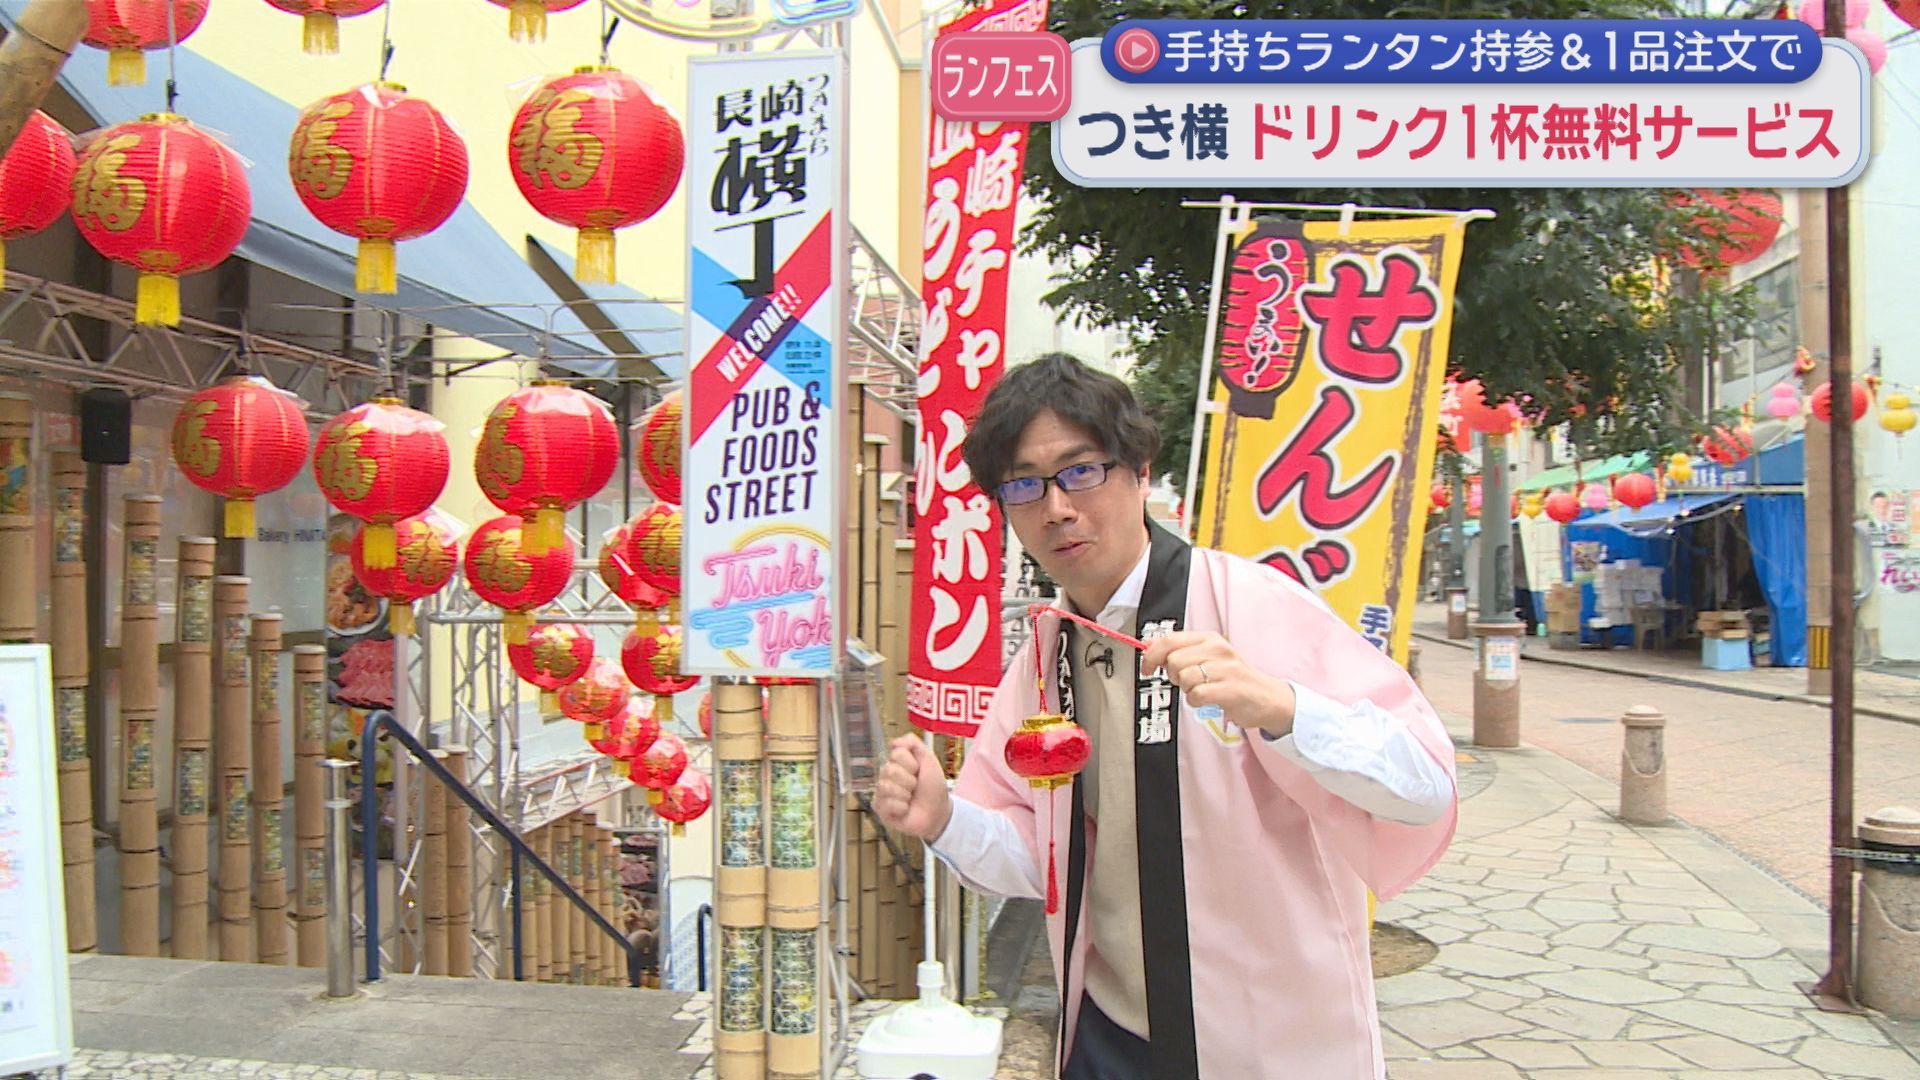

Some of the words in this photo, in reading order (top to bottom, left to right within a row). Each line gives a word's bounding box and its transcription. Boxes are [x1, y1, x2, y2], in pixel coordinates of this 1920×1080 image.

[713, 79, 804, 133] 長崎
[710, 124, 807, 300] 横丁
[715, 282, 802, 383] WELCOME!!
[731, 385, 791, 432] PUB
[800, 381, 822, 421] &
[722, 425, 818, 478] FOODS
[704, 469, 818, 525] STREET
[702, 543, 825, 609] Tsuki
